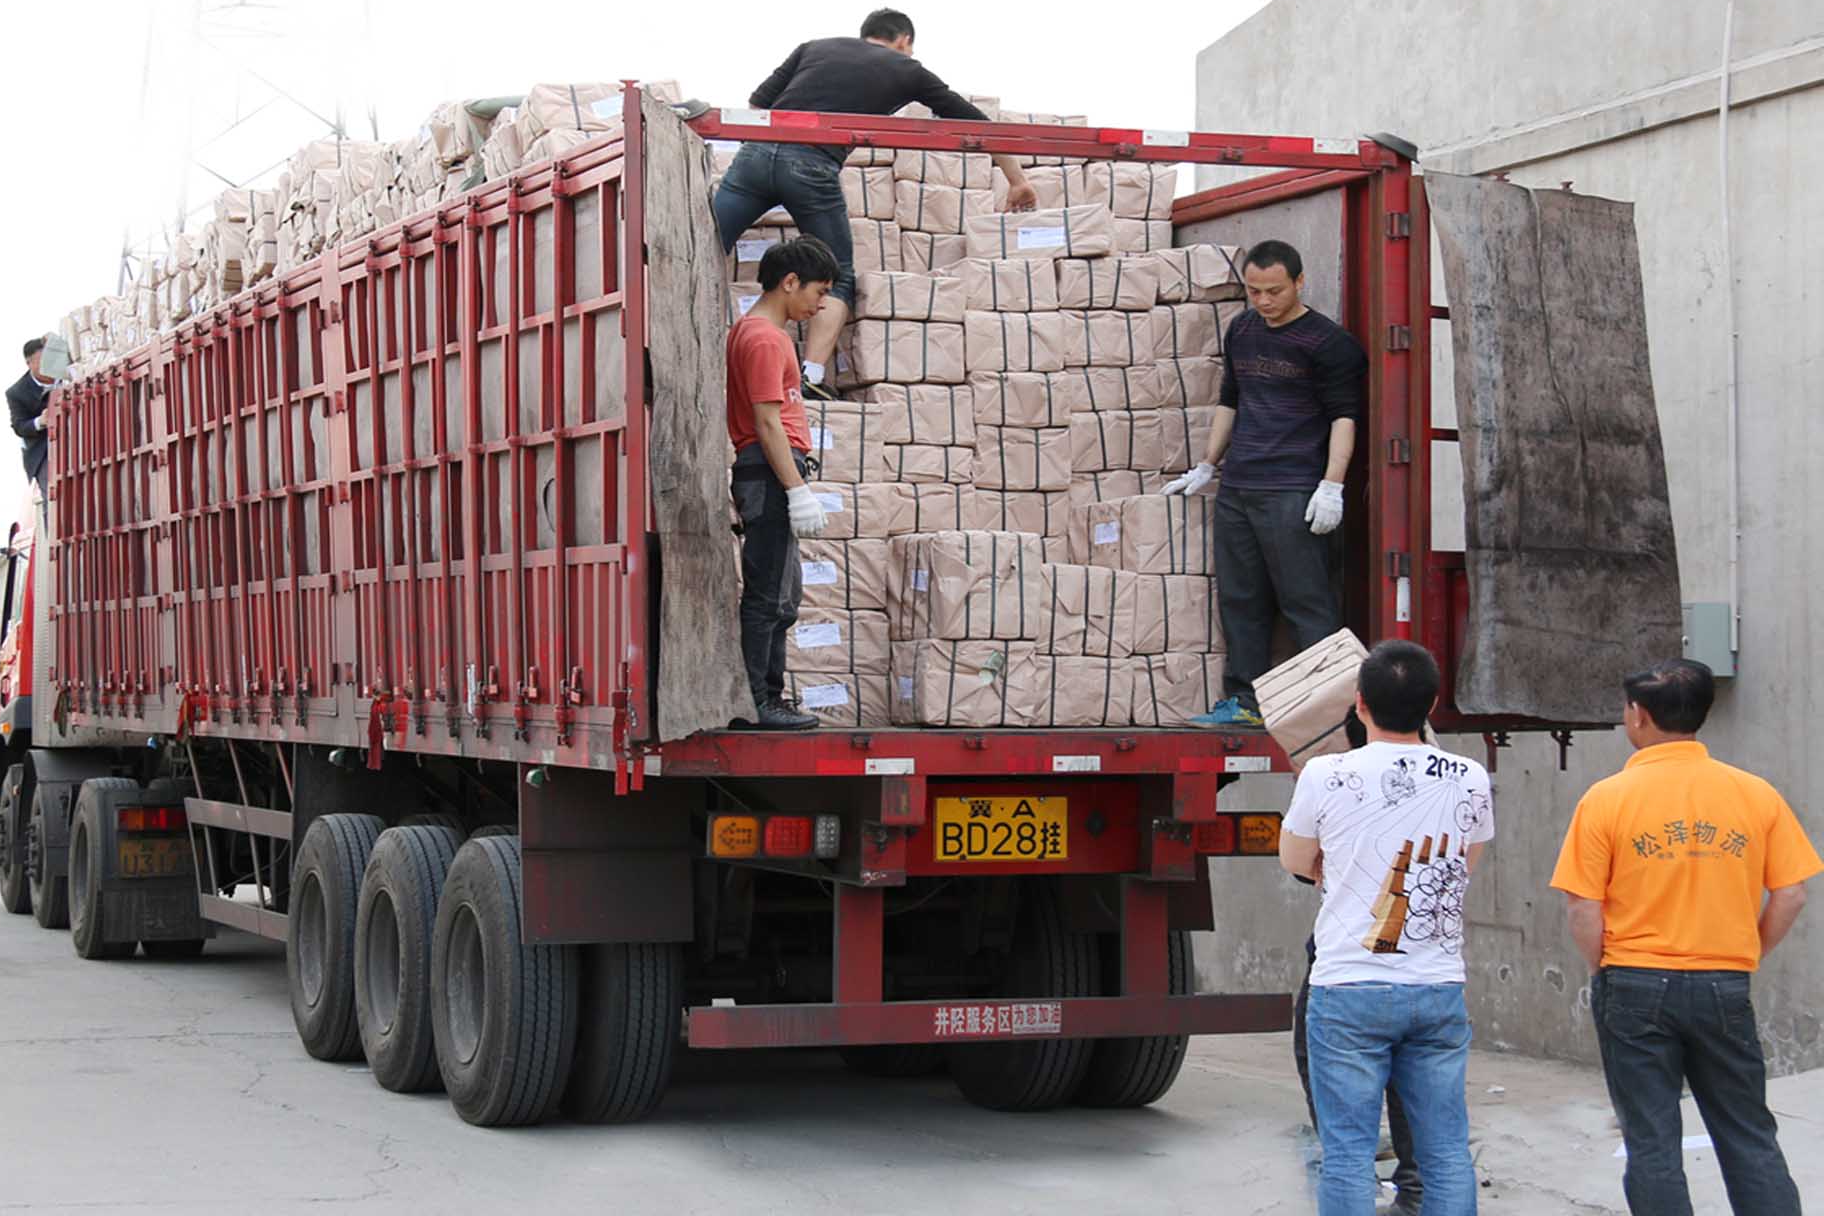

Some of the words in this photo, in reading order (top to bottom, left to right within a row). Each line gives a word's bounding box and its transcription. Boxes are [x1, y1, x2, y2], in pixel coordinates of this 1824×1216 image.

[942, 821, 1061, 858] BD28挂
[1631, 819, 1750, 859] 松泽物流
